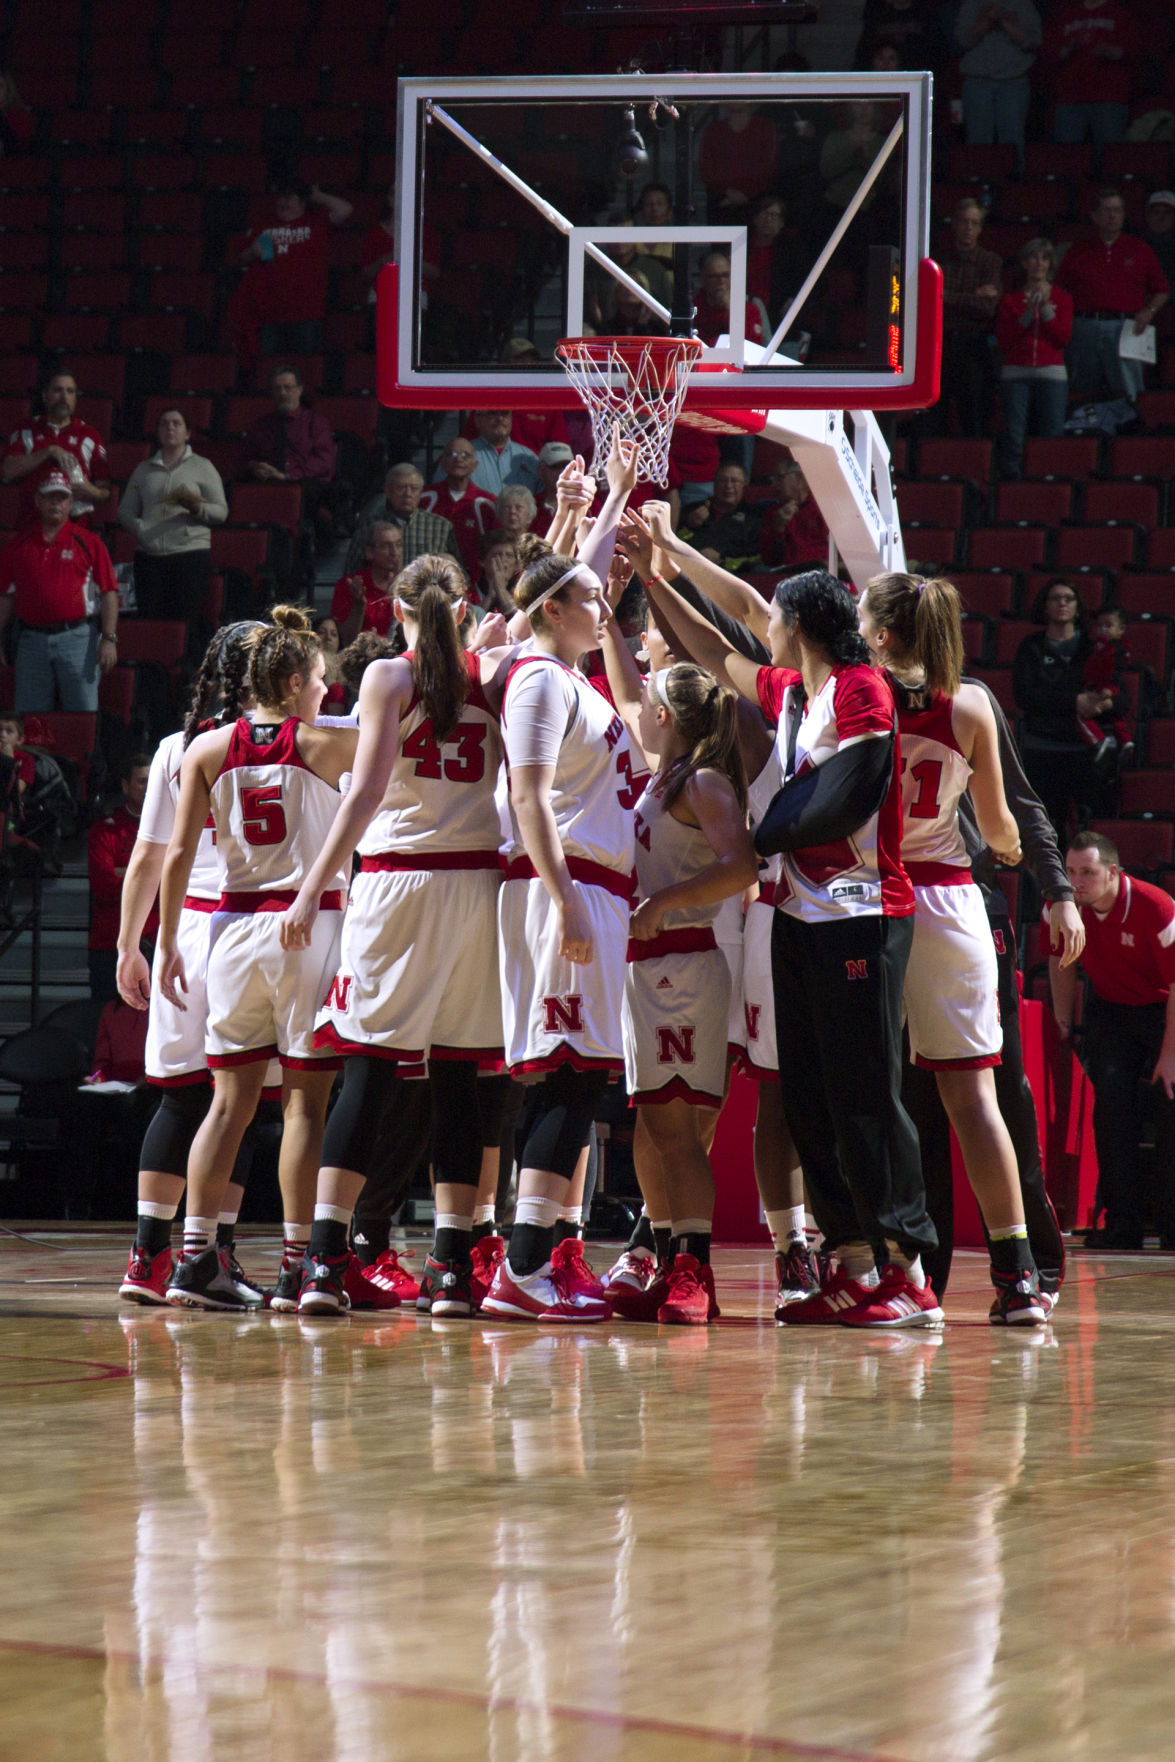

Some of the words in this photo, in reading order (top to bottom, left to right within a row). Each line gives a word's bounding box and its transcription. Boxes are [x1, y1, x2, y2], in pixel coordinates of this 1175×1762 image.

[908, 693, 924, 709] N
[255, 727, 274, 744] N
[402, 716, 487, 783] 43
[900, 758, 943, 819] 1
[240, 785, 287, 846] 5
[1120, 931, 1136, 947] N
[845, 960, 869, 980] N
[323, 975, 354, 1014] N
[542, 993, 585, 1034] N
[655, 1025, 696, 1065] N
